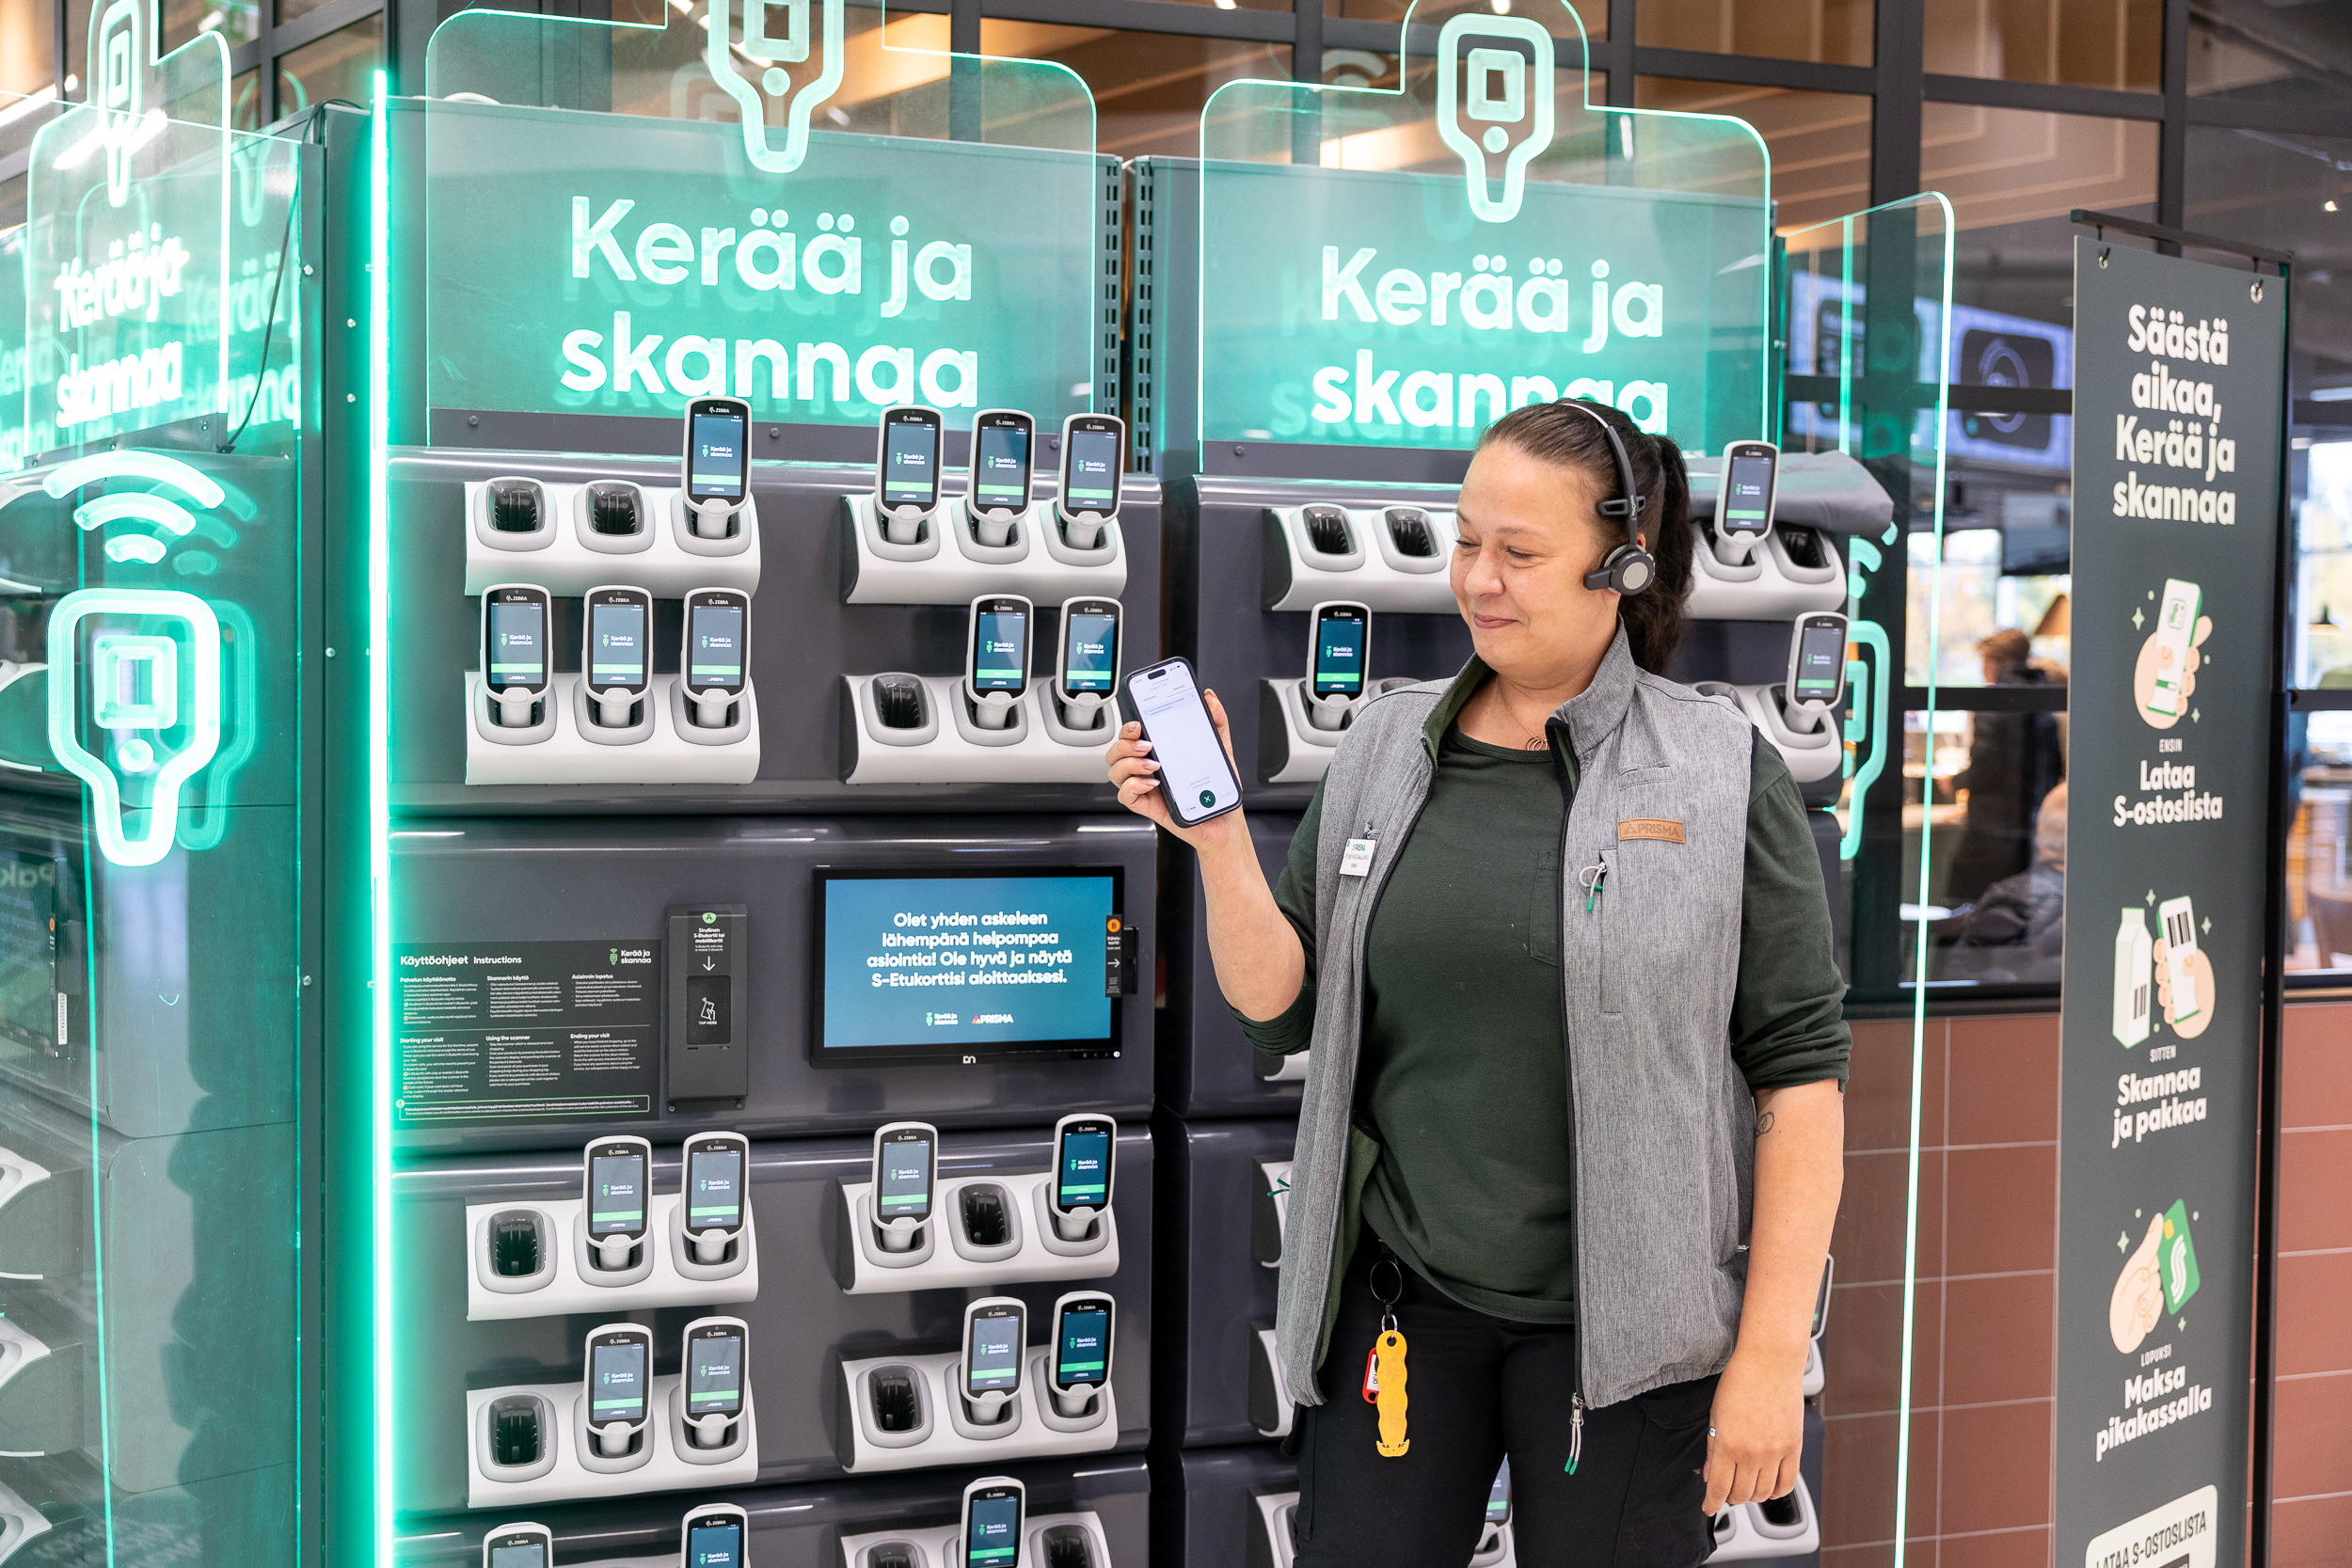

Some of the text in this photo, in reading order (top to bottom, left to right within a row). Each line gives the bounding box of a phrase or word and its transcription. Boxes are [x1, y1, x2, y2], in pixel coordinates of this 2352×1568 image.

[571, 195, 972, 318] Kerää ja
[1322, 245, 1663, 354] Kerää ja
[2127, 303, 2229, 366] Säästä
[560, 310, 977, 407] skannaa
[56, 341, 183, 428] skannaa
[2132, 362, 2223, 422] aikaa,
[2116, 414, 2235, 483] Kerää ja
[2113, 471, 2235, 525] skannaa
[2159, 738, 2183, 752] ENSIN
[2140, 760, 2195, 792] Lataa
[2113, 790, 2223, 827] S-ostoslista
[1638, 824, 1679, 838] PRISMA
[894, 911, 1048, 929] Olet yhden askeleen
[866, 950, 1073, 968] asiointia! Ole hyvä ja näytä
[882, 931, 1058, 949] lähempänä helpompaa
[400, 955, 522, 967] Käyttöohjeet Instructions
[871, 969, 1067, 988] S-Etukorttisi aloittaaksesi.
[980, 1014, 1013, 1023] PRISMA
[2150, 1045, 2176, 1063] SITTEN
[2118, 1067, 2201, 1106] Skannaa
[2112, 1098, 2206, 1149] ja pakkaa
[2140, 1343, 2171, 1367] LOPUKSI
[2124, 1365, 2185, 1409] Maksa
[2096, 1386, 2212, 1463] pikakassalla
[2133, 1510, 2206, 1565] S-OSTOSLISTA
